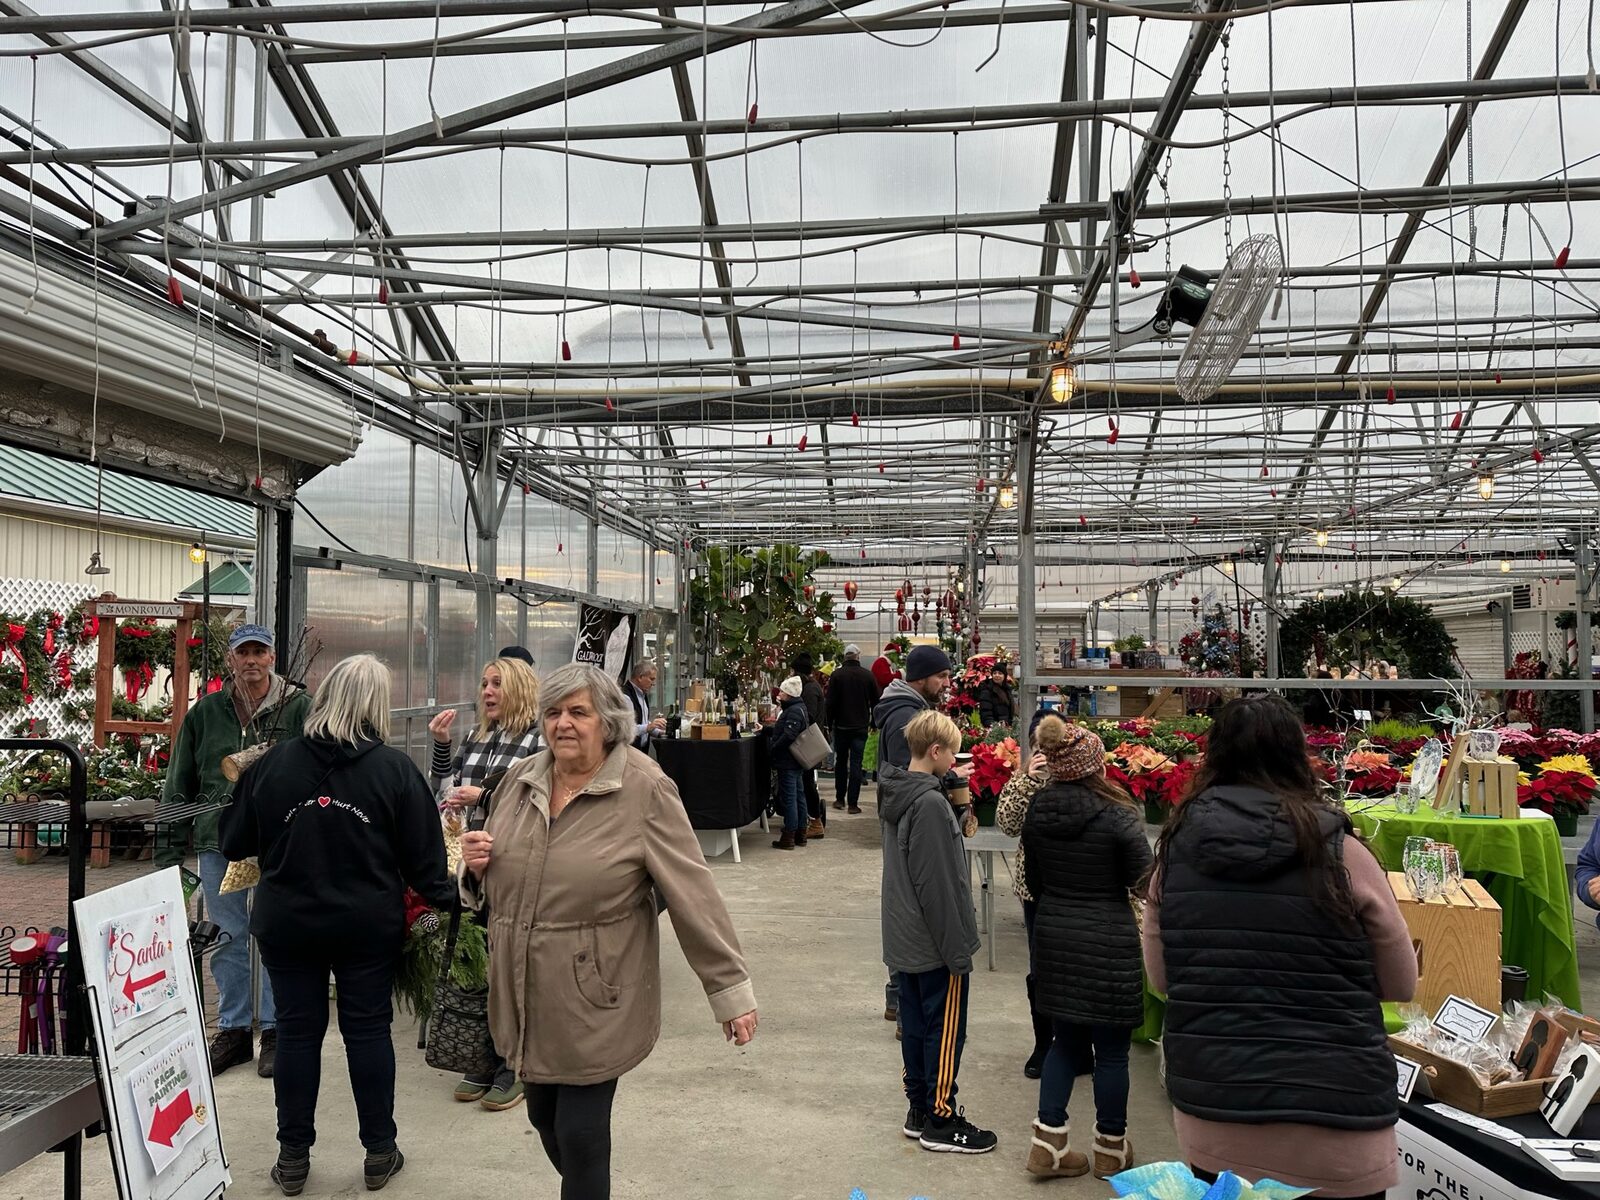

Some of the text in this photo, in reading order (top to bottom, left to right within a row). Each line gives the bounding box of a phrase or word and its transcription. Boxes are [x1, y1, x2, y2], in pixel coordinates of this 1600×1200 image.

[115, 605, 173, 615] MONROVIA
[332, 799, 351, 810] Hurt
[350, 806, 371, 823] Never
[114, 932, 165, 977] Santa
[149, 1069, 188, 1107] PAINTING
[154, 1066, 175, 1088] FACE
[1434, 1169, 1469, 1200] THE
